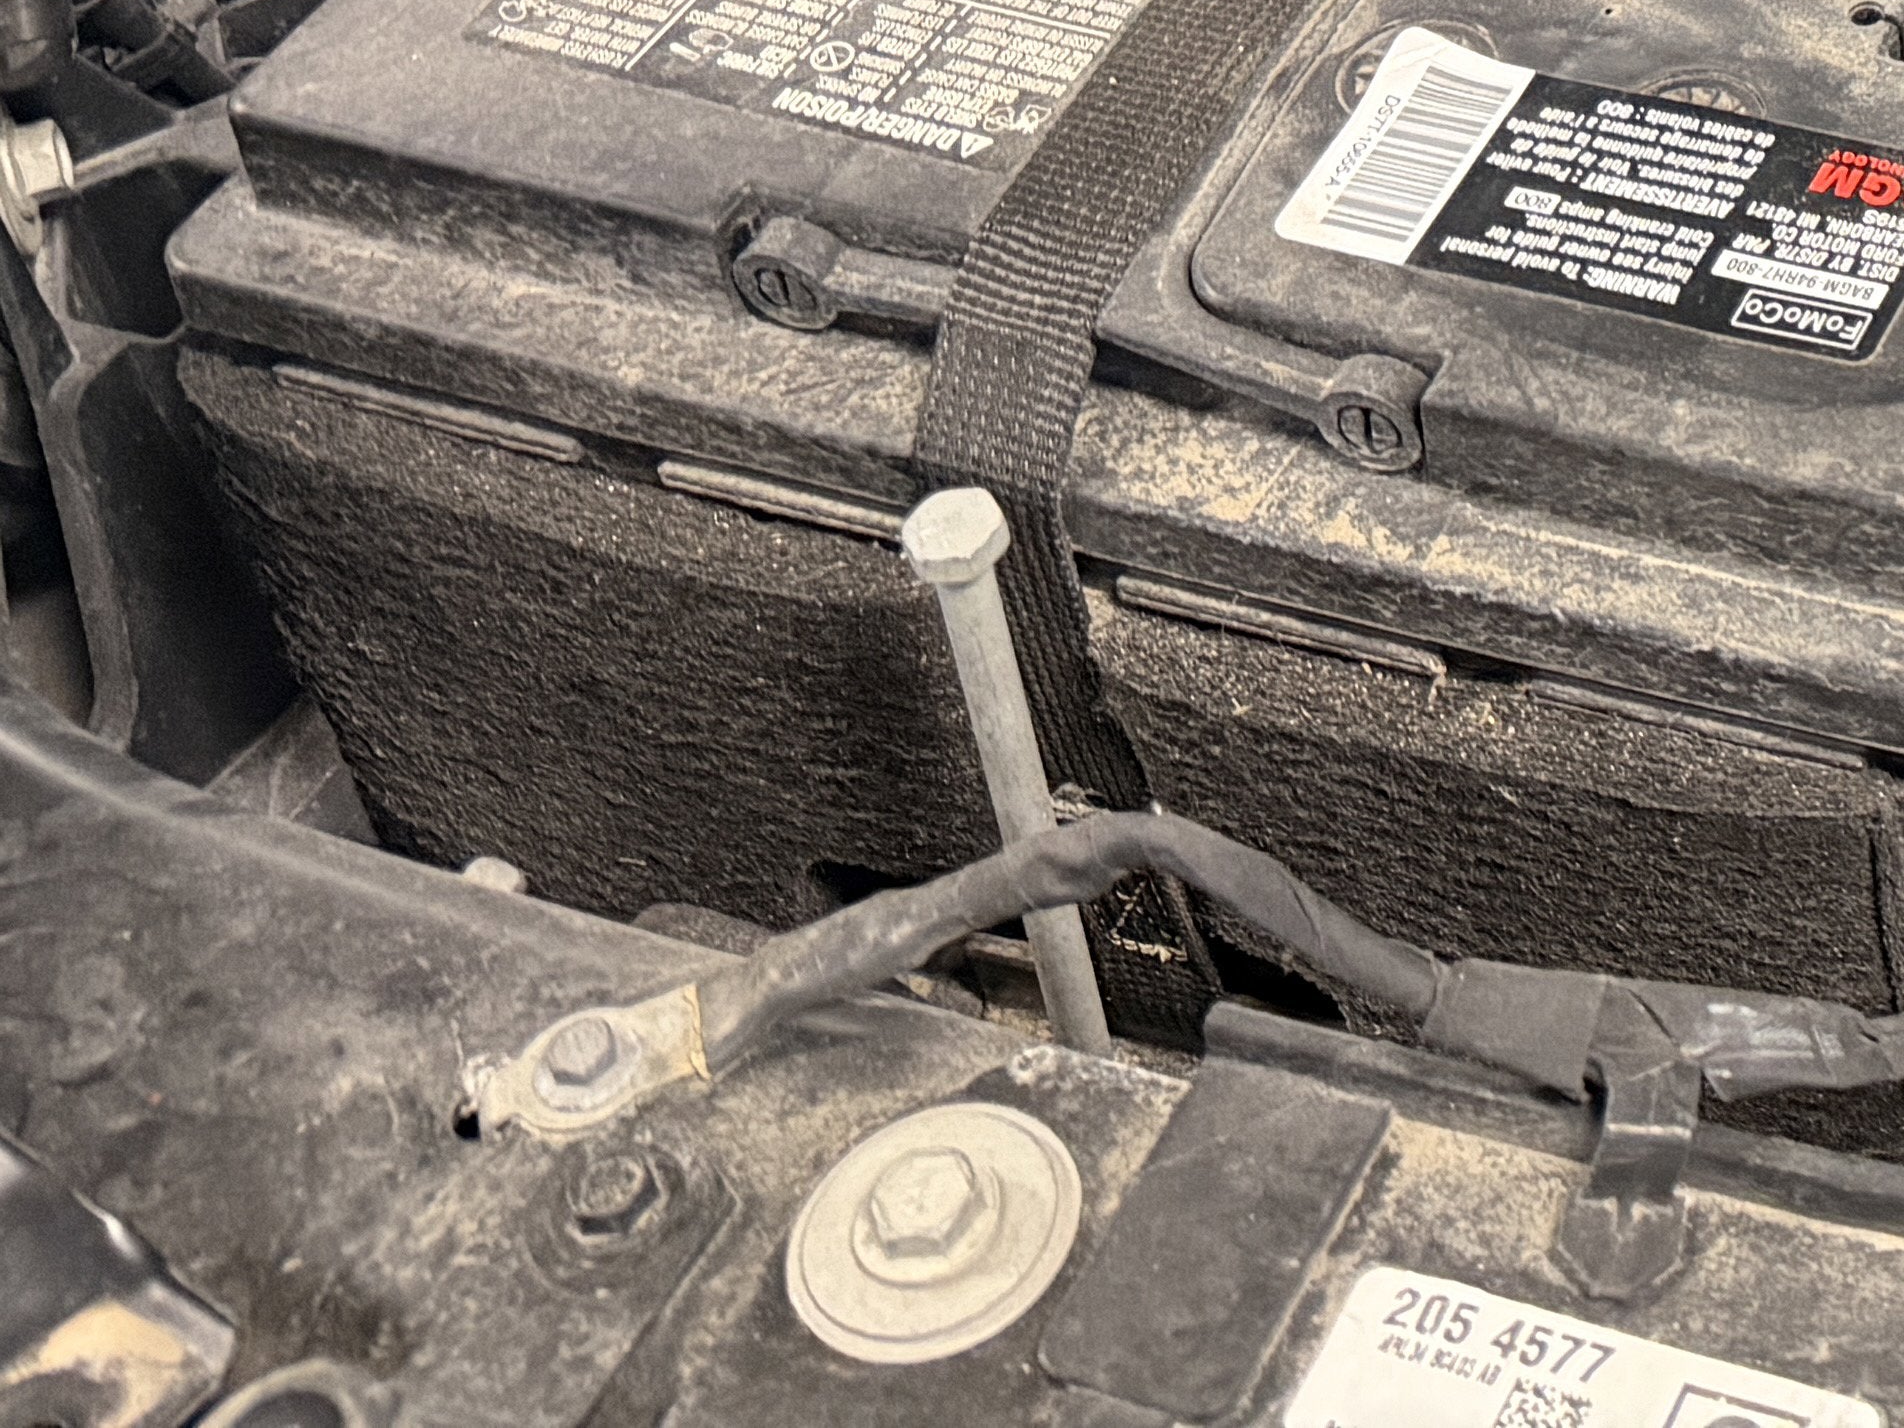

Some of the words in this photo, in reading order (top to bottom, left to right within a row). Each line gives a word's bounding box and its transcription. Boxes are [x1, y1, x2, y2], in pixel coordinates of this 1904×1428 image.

[775, 89, 959, 148] DANGER/POISON
[1532, 161, 1571, 181] Pour
[1598, 157, 1630, 176] Voir
[1514, 193, 1552, 209] 800
[1582, 174, 1732, 216] AVERTISSEMENT
[1559, 201, 1604, 221] amps
[1747, 201, 1795, 223] 48121
[1796, 212, 1820, 229] MI
[1606, 209, 1674, 236] cranking
[1772, 223, 1798, 242] CO.
[1485, 225, 1511, 243] for
[1620, 234, 1660, 253] start
[1674, 226, 1713, 249] Cold
[1732, 233, 1770, 253] PAR
[1799, 231, 1860, 255] MOTOR
[1440, 237, 1514, 261] personal
[1559, 242, 1610, 261] owner
[1775, 243, 1828, 266] DISTR.
[1512, 251, 1560, 271] avoid
[1561, 261, 1580, 280] To
[1612, 252, 1643, 269] see
[1828, 255, 1854, 272] BY
[1858, 260, 1899, 282] DIST.
[1584, 267, 1679, 303] WARNING:
[1746, 299, 1862, 340] FoMoCo
[1382, 1286, 1480, 1344] 205
[1490, 1318, 1617, 1385] 4577
